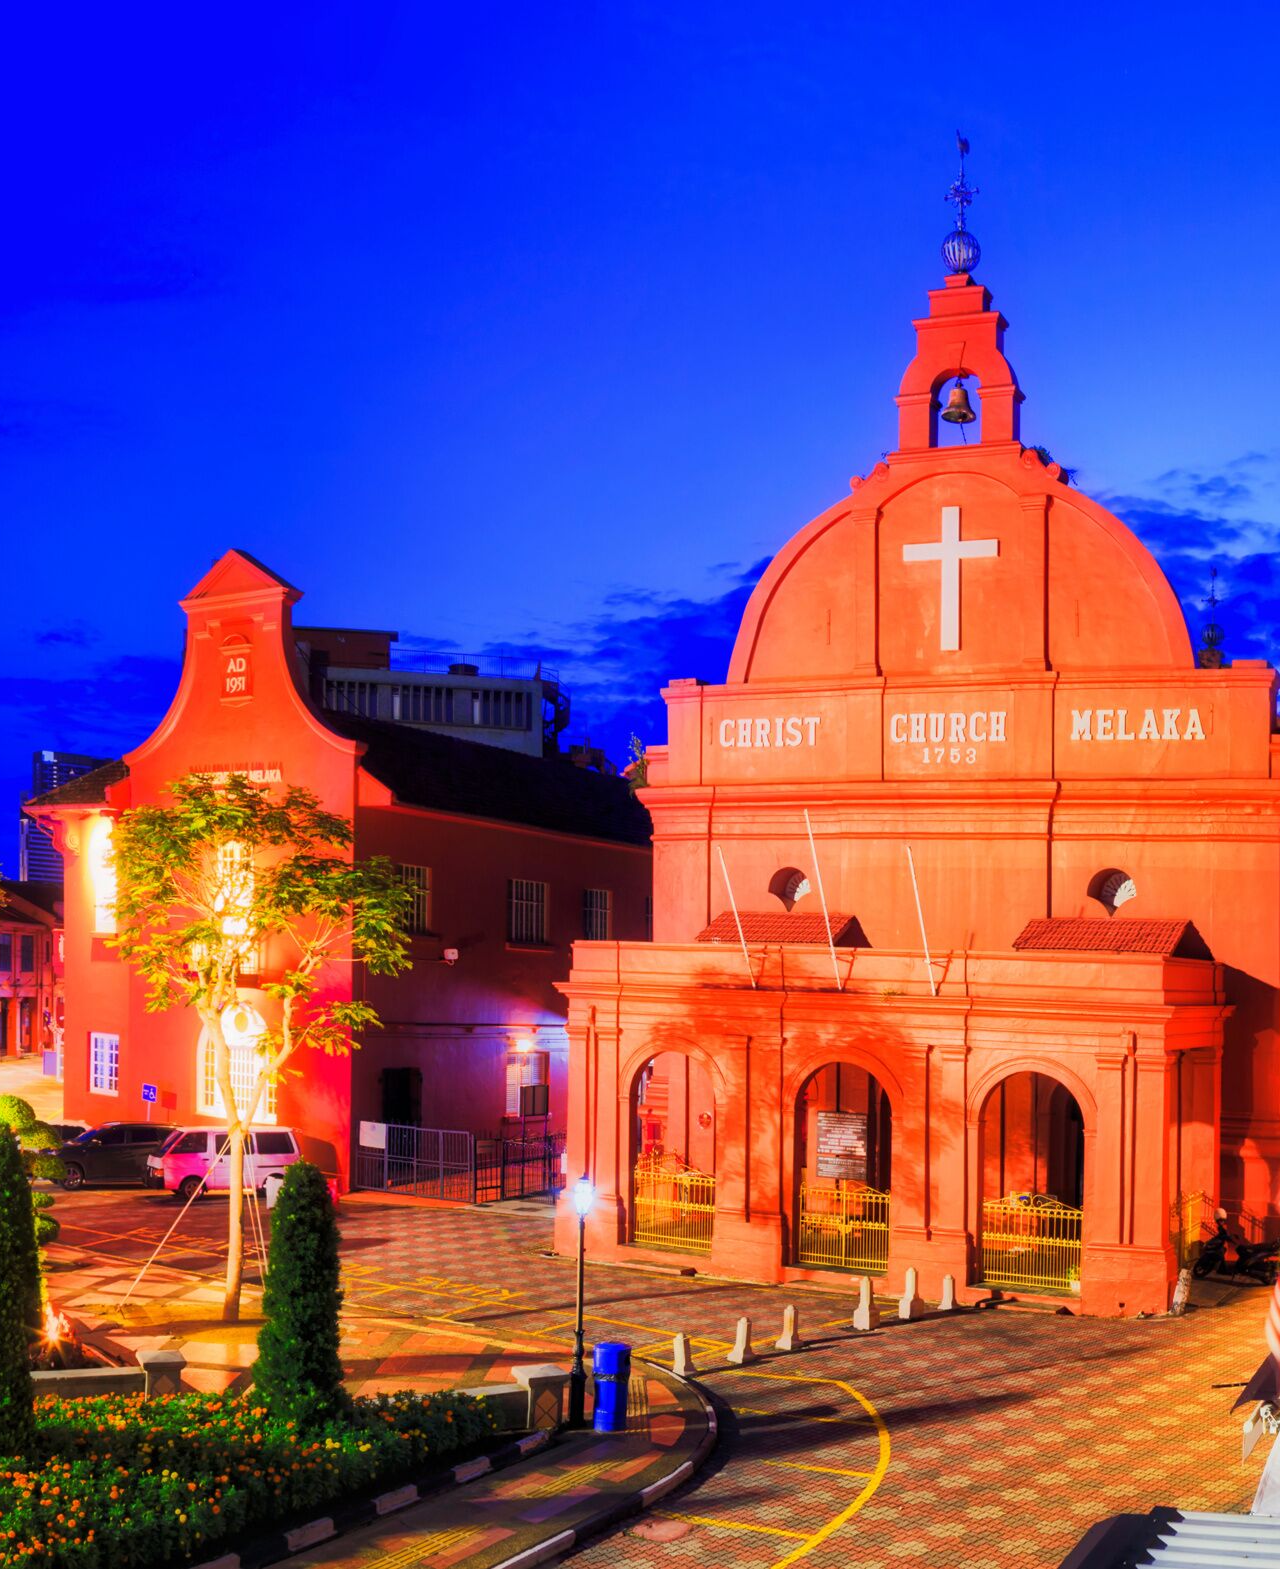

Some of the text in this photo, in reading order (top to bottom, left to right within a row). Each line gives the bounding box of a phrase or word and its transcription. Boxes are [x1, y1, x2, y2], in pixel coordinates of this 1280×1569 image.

[227, 658, 246, 673] AD
[720, 708, 1206, 748] CHRIST CHURCH MELAKA
[922, 747, 977, 764] 1753
[249, 769, 282, 784] MELAKA
